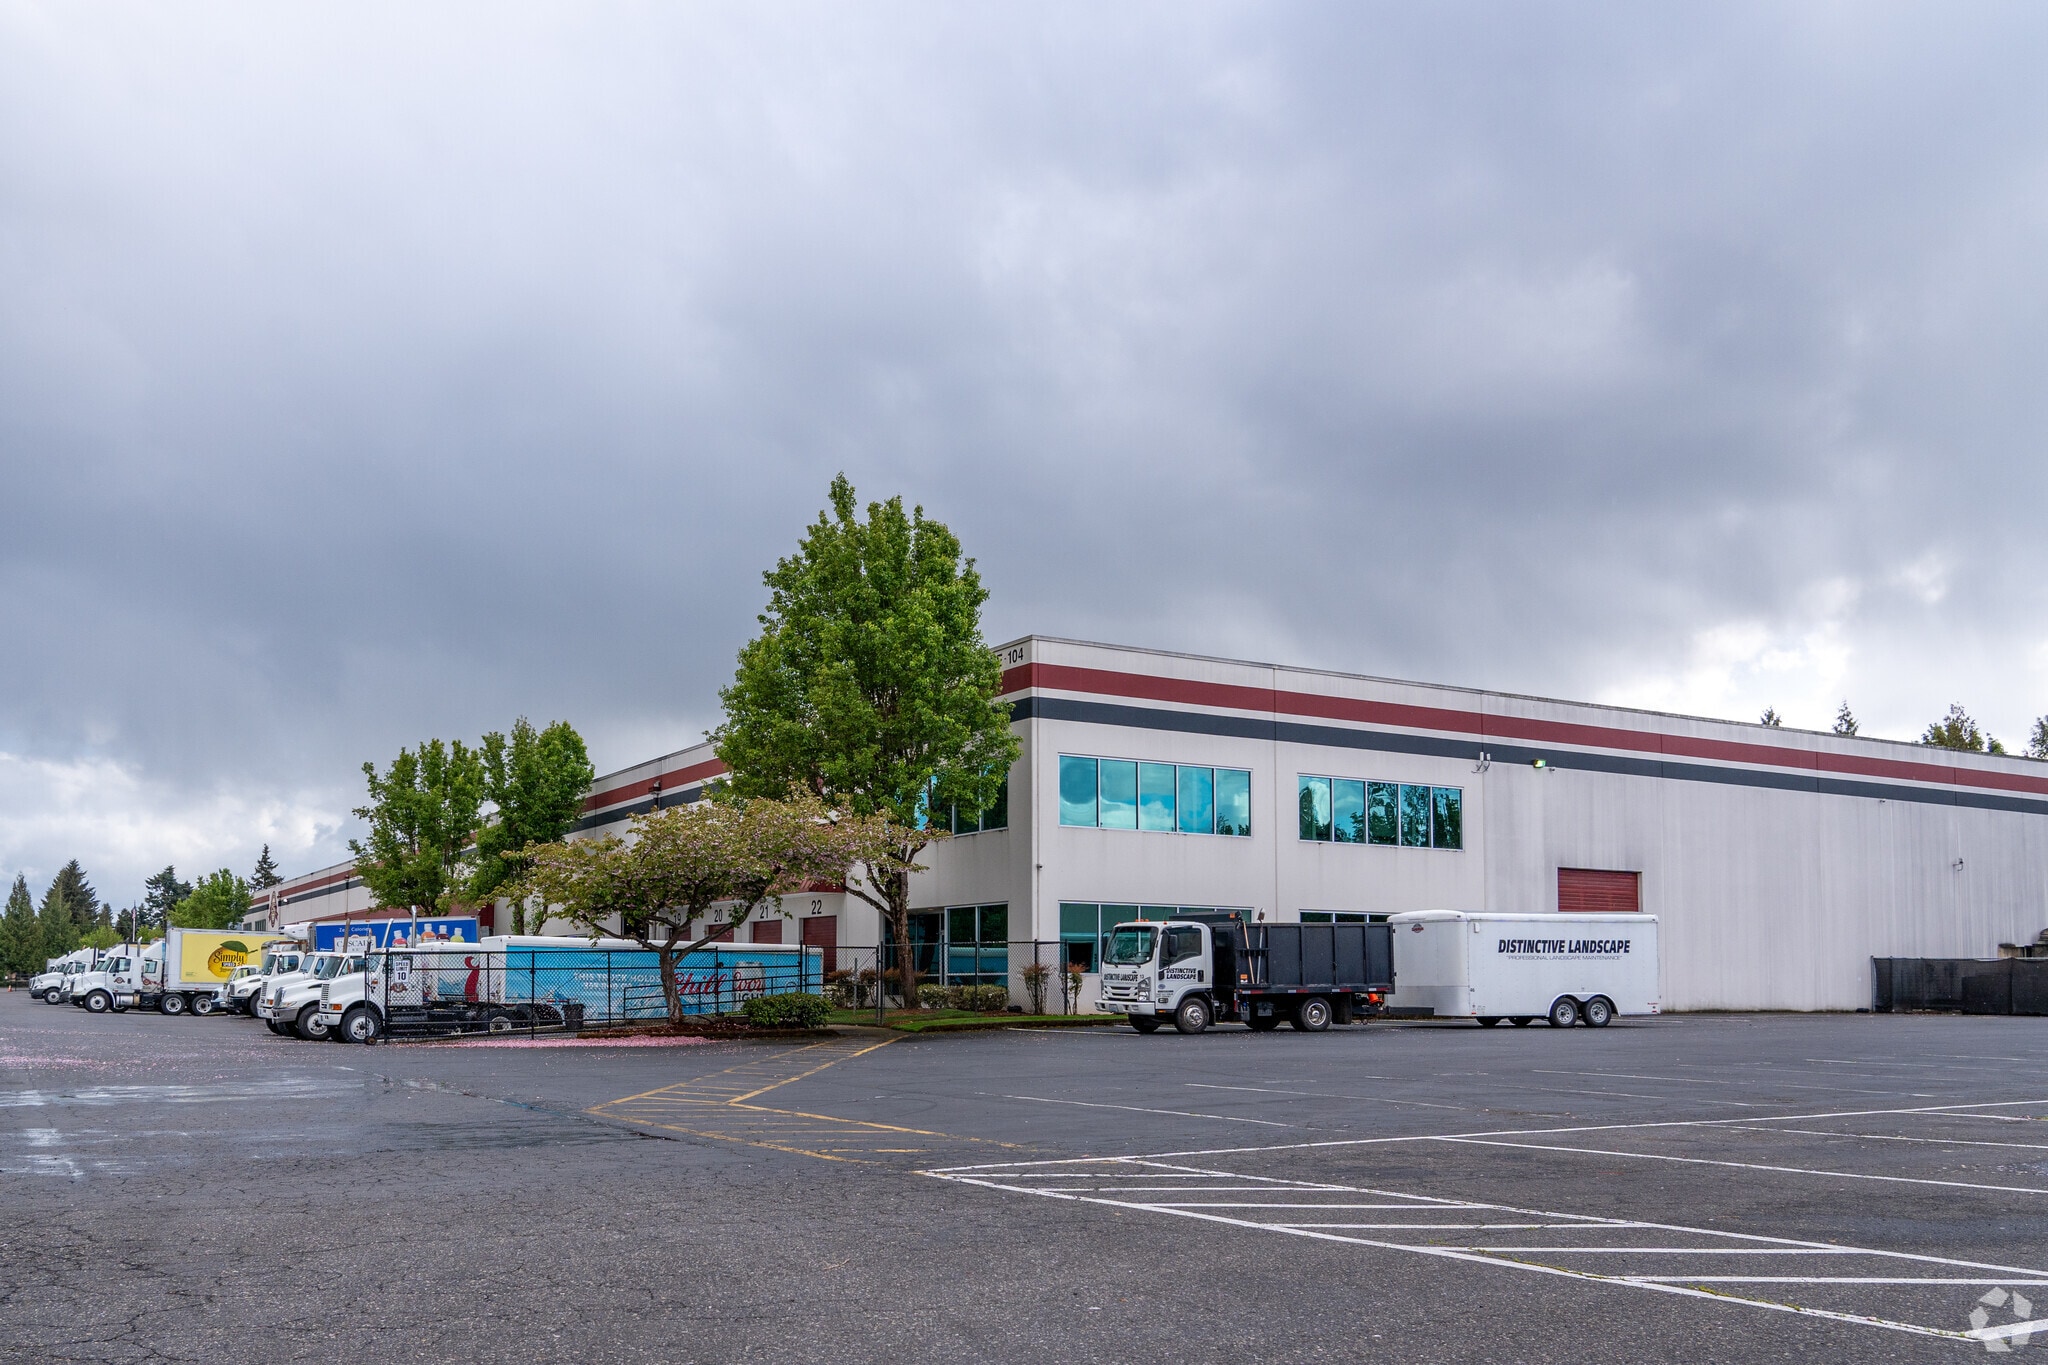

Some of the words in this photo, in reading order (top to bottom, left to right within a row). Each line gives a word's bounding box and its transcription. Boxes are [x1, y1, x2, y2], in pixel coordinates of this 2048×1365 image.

[759, 905, 769, 919] 21
[811, 900, 822, 914] 22
[714, 909, 723, 922] 20
[1498, 939, 1566, 954] DISTINCTIVE
[1568, 939, 1631, 954] LANDSCAPE
[213, 951, 244, 965] Simply
[397, 972, 406, 981] 10
